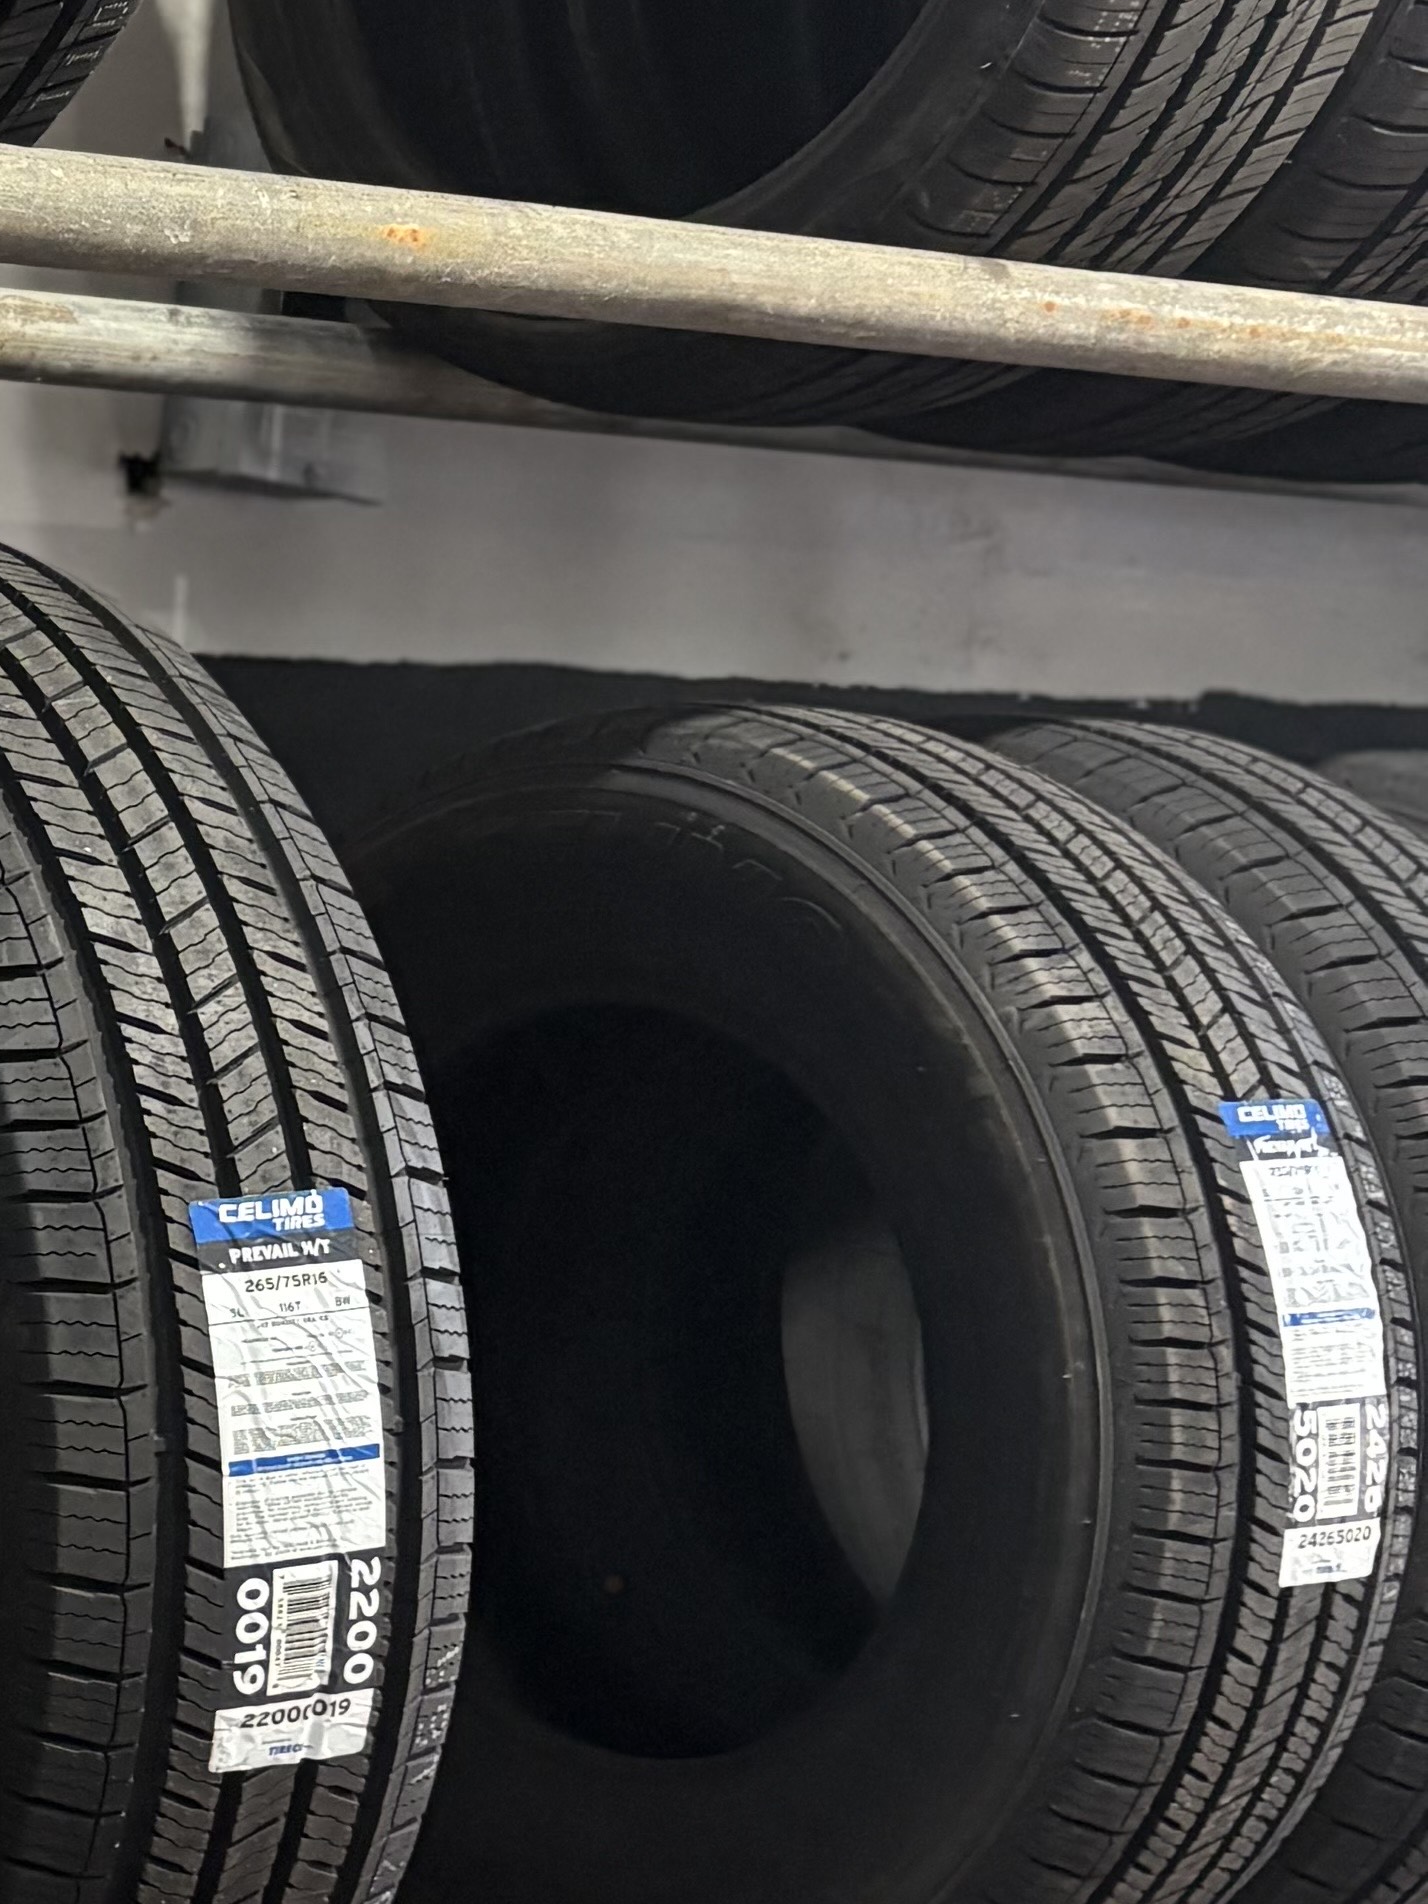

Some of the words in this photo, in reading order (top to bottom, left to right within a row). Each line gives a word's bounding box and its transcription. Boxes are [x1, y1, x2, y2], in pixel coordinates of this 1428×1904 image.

[1237, 1104, 1307, 1122] CELIMO
[218, 1194, 325, 1223] CELIMO
[272, 1213, 325, 1231] TIRES
[229, 1246, 295, 1264] PREVAIL
[245, 1272, 328, 1292] 265/75R16
[1294, 1410, 1318, 1522] 5020
[1298, 1525, 1372, 1549] 24265020
[343, 1556, 382, 1684] 2200
[233, 1577, 270, 1695] 0019
